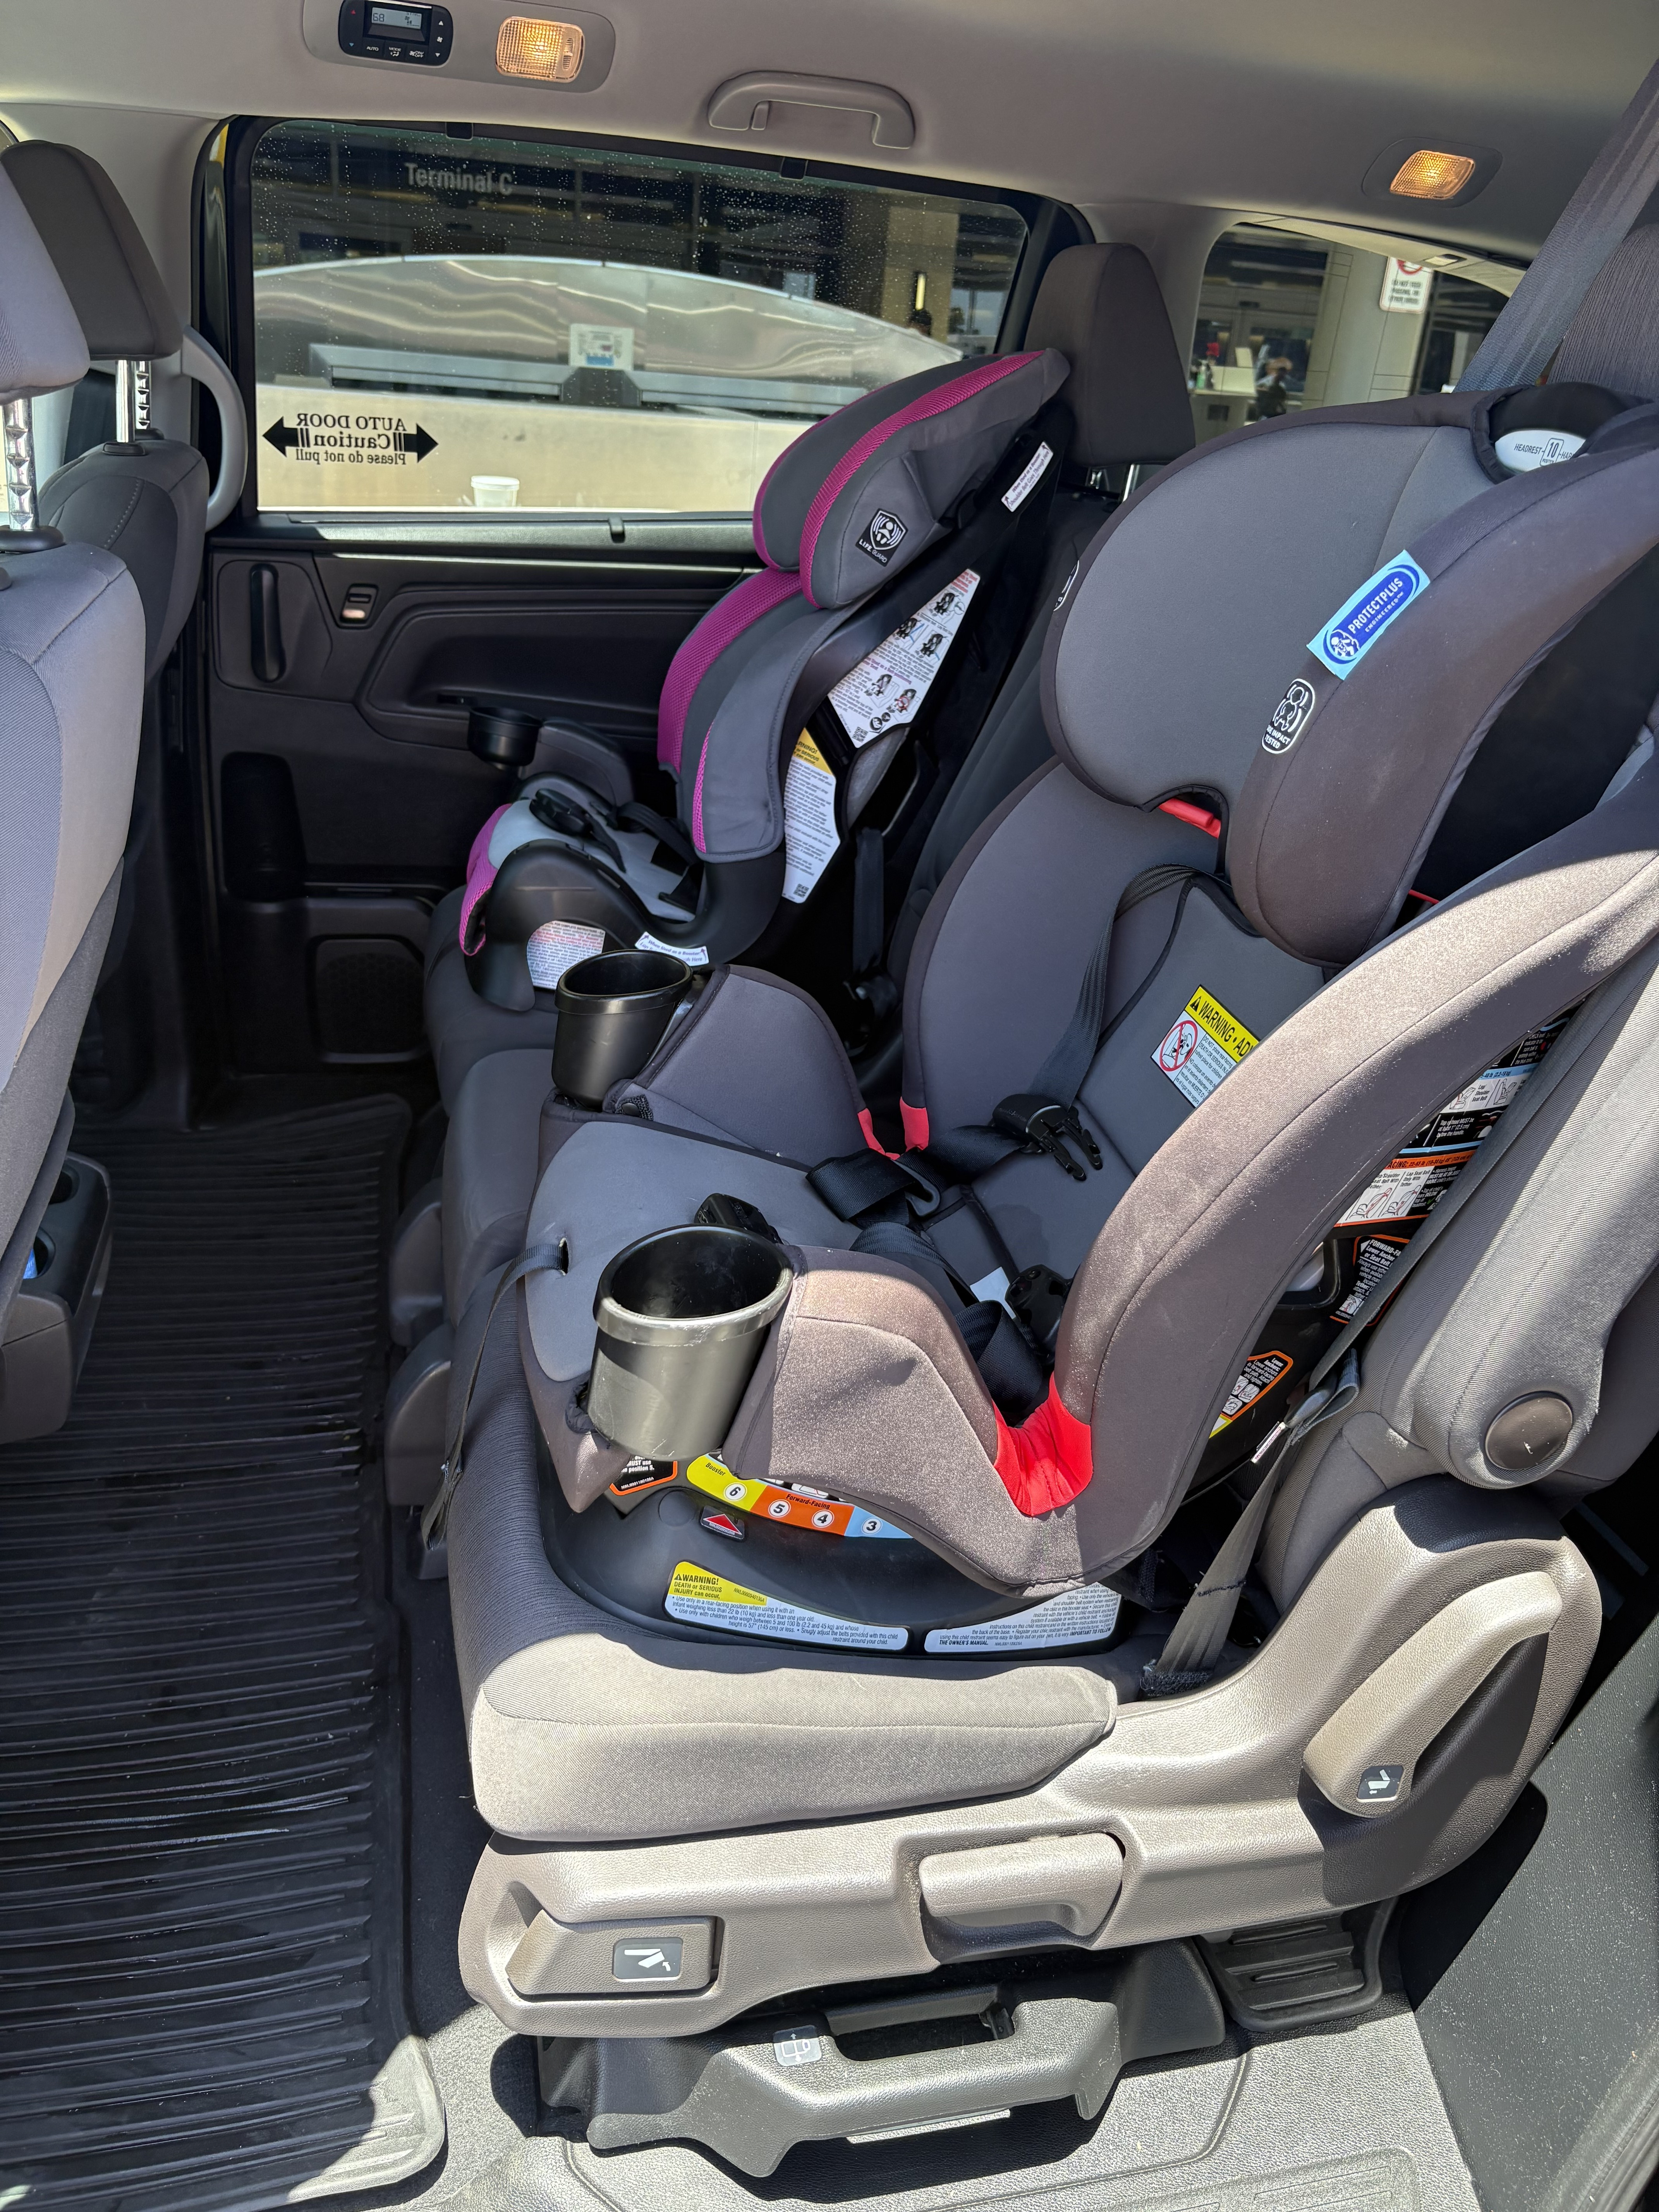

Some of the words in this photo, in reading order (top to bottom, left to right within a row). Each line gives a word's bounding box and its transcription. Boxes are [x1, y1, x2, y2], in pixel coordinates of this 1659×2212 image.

[373, 13, 385, 22] 68
[404, 162, 492, 193] Terminal
[500, 173, 512, 195] C
[1514, 443, 1542, 455] HEADREST
[1547, 441, 1559, 458] 10
[859, 539, 872, 552] LIFE
[872, 550, 887, 563] GUARD
[1348, 577, 1403, 634] PROTECTPLUS
[1264, 734, 1280, 749] TESTED
[1271, 730, 1290, 744] IMPACT
[1199, 1001, 1235, 1042] WARNING
[1365, 1245, 1380, 1254] Lower
[1369, 1254, 1381, 1262] Seat
[1271, 1357, 1283, 1367] Lower
[628, 1465, 649, 1473] position
[705, 1462, 726, 1477] Booster
[730, 1487, 741, 1497] 6
[786, 1494, 830, 1509] Forward-Facing
[775, 1504, 785, 1514] 5
[817, 1514, 828, 1524] 4
[866, 1521, 877, 1531] 3
[682, 1574, 719, 1585] WARNING!
[705, 1600, 729, 1608] rear-facing
[730, 1602, 748, 1611] position
[728, 1620, 742, 1628] height
